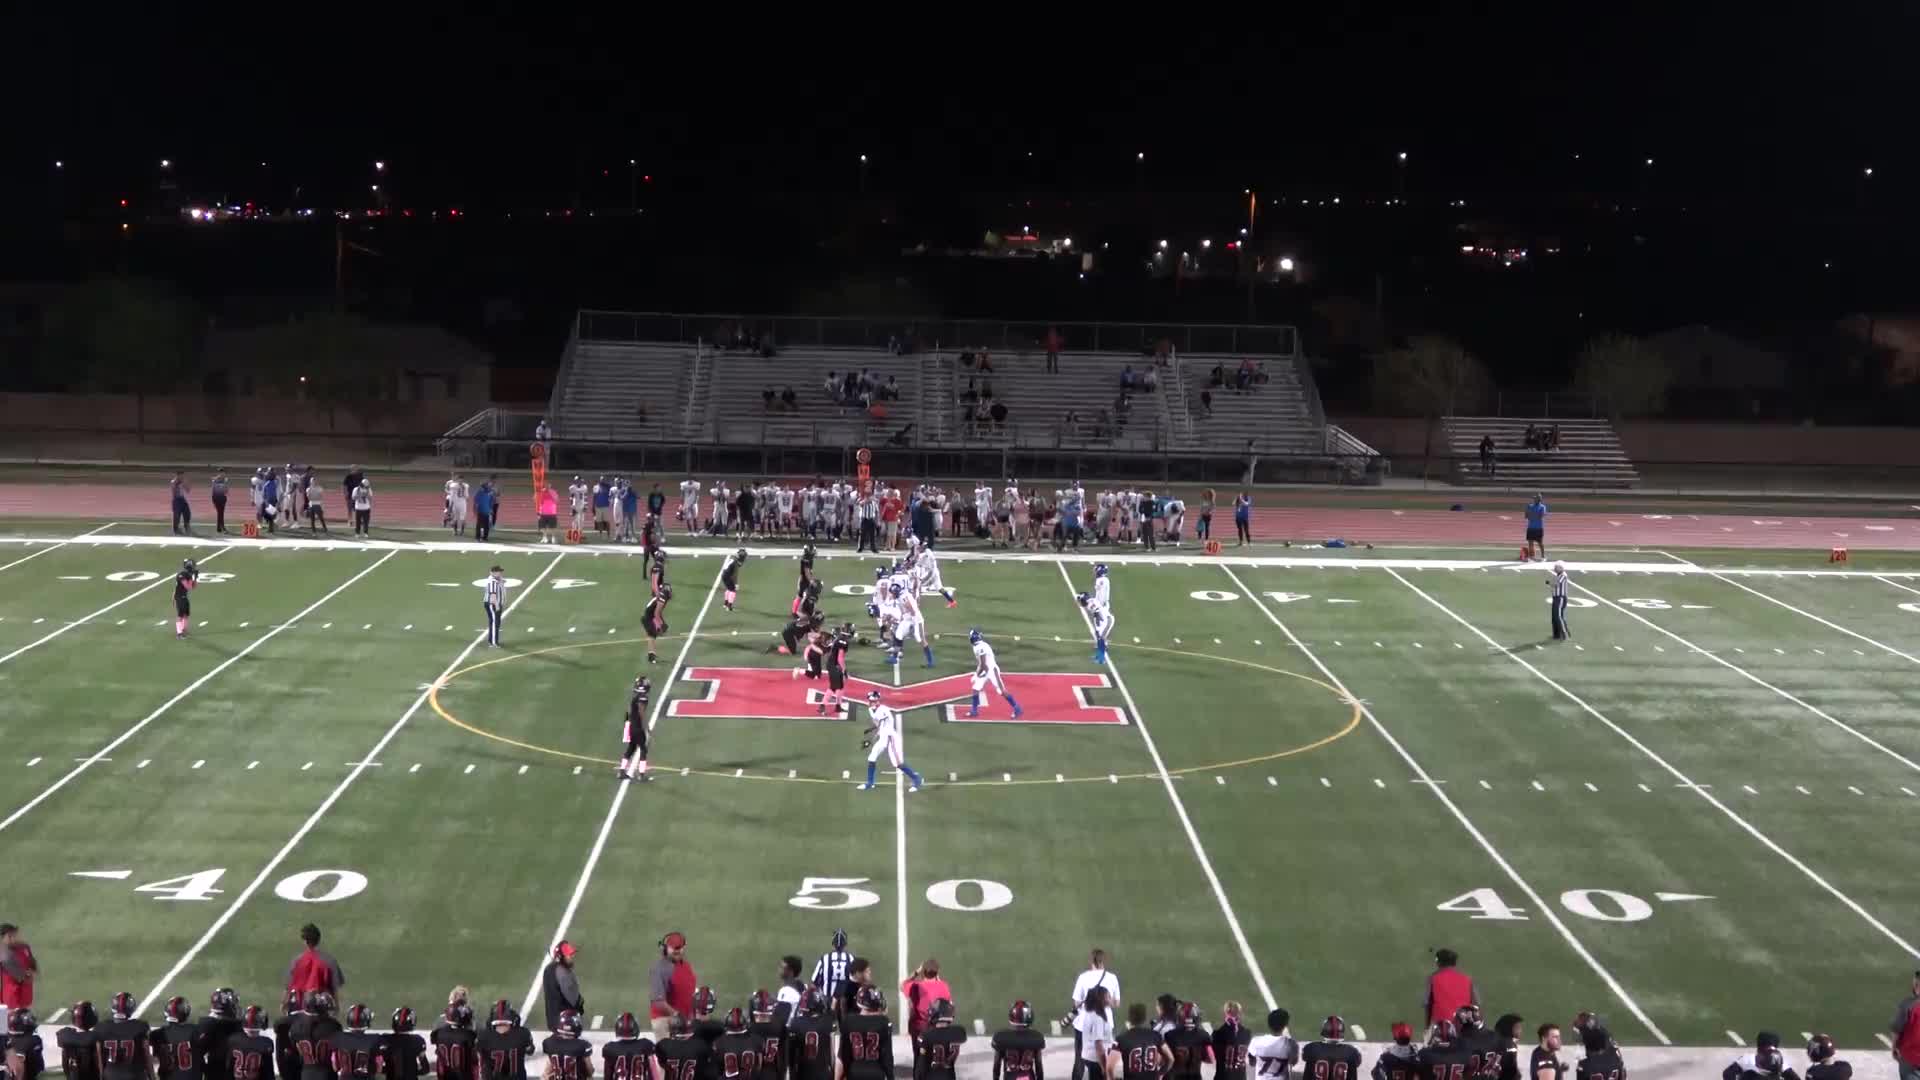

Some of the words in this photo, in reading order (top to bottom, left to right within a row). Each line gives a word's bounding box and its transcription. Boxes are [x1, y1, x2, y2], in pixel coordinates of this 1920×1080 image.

[1206, 541, 1218, 553] 40
[1834, 551, 1847, 562] 20
[831, 961, 846, 981] H
[103, 1040, 135, 1063] 77
